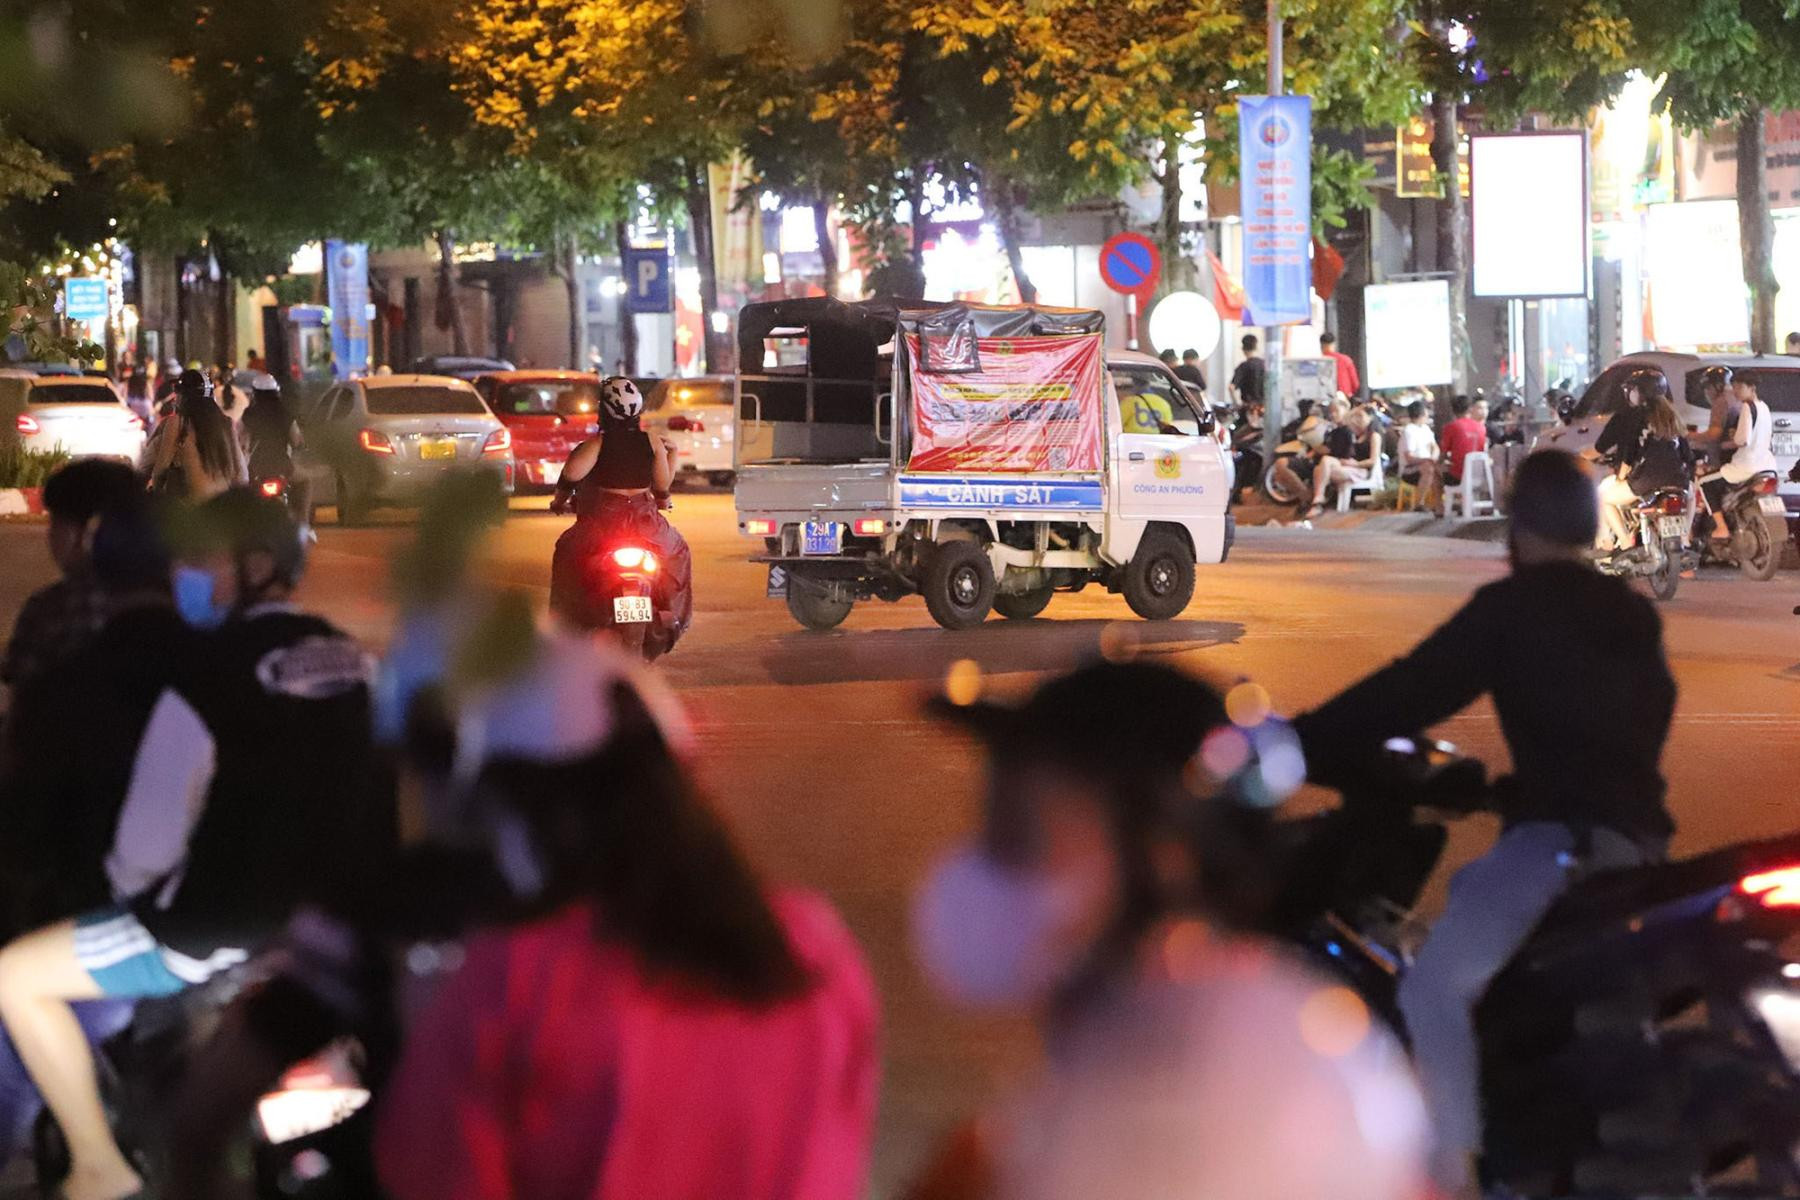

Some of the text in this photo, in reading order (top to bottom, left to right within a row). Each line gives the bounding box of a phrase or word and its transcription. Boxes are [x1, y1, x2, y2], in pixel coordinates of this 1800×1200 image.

[638, 260, 657, 297] P
[1158, 485, 1170, 493] AN
[812, 521, 830, 536] 29A
